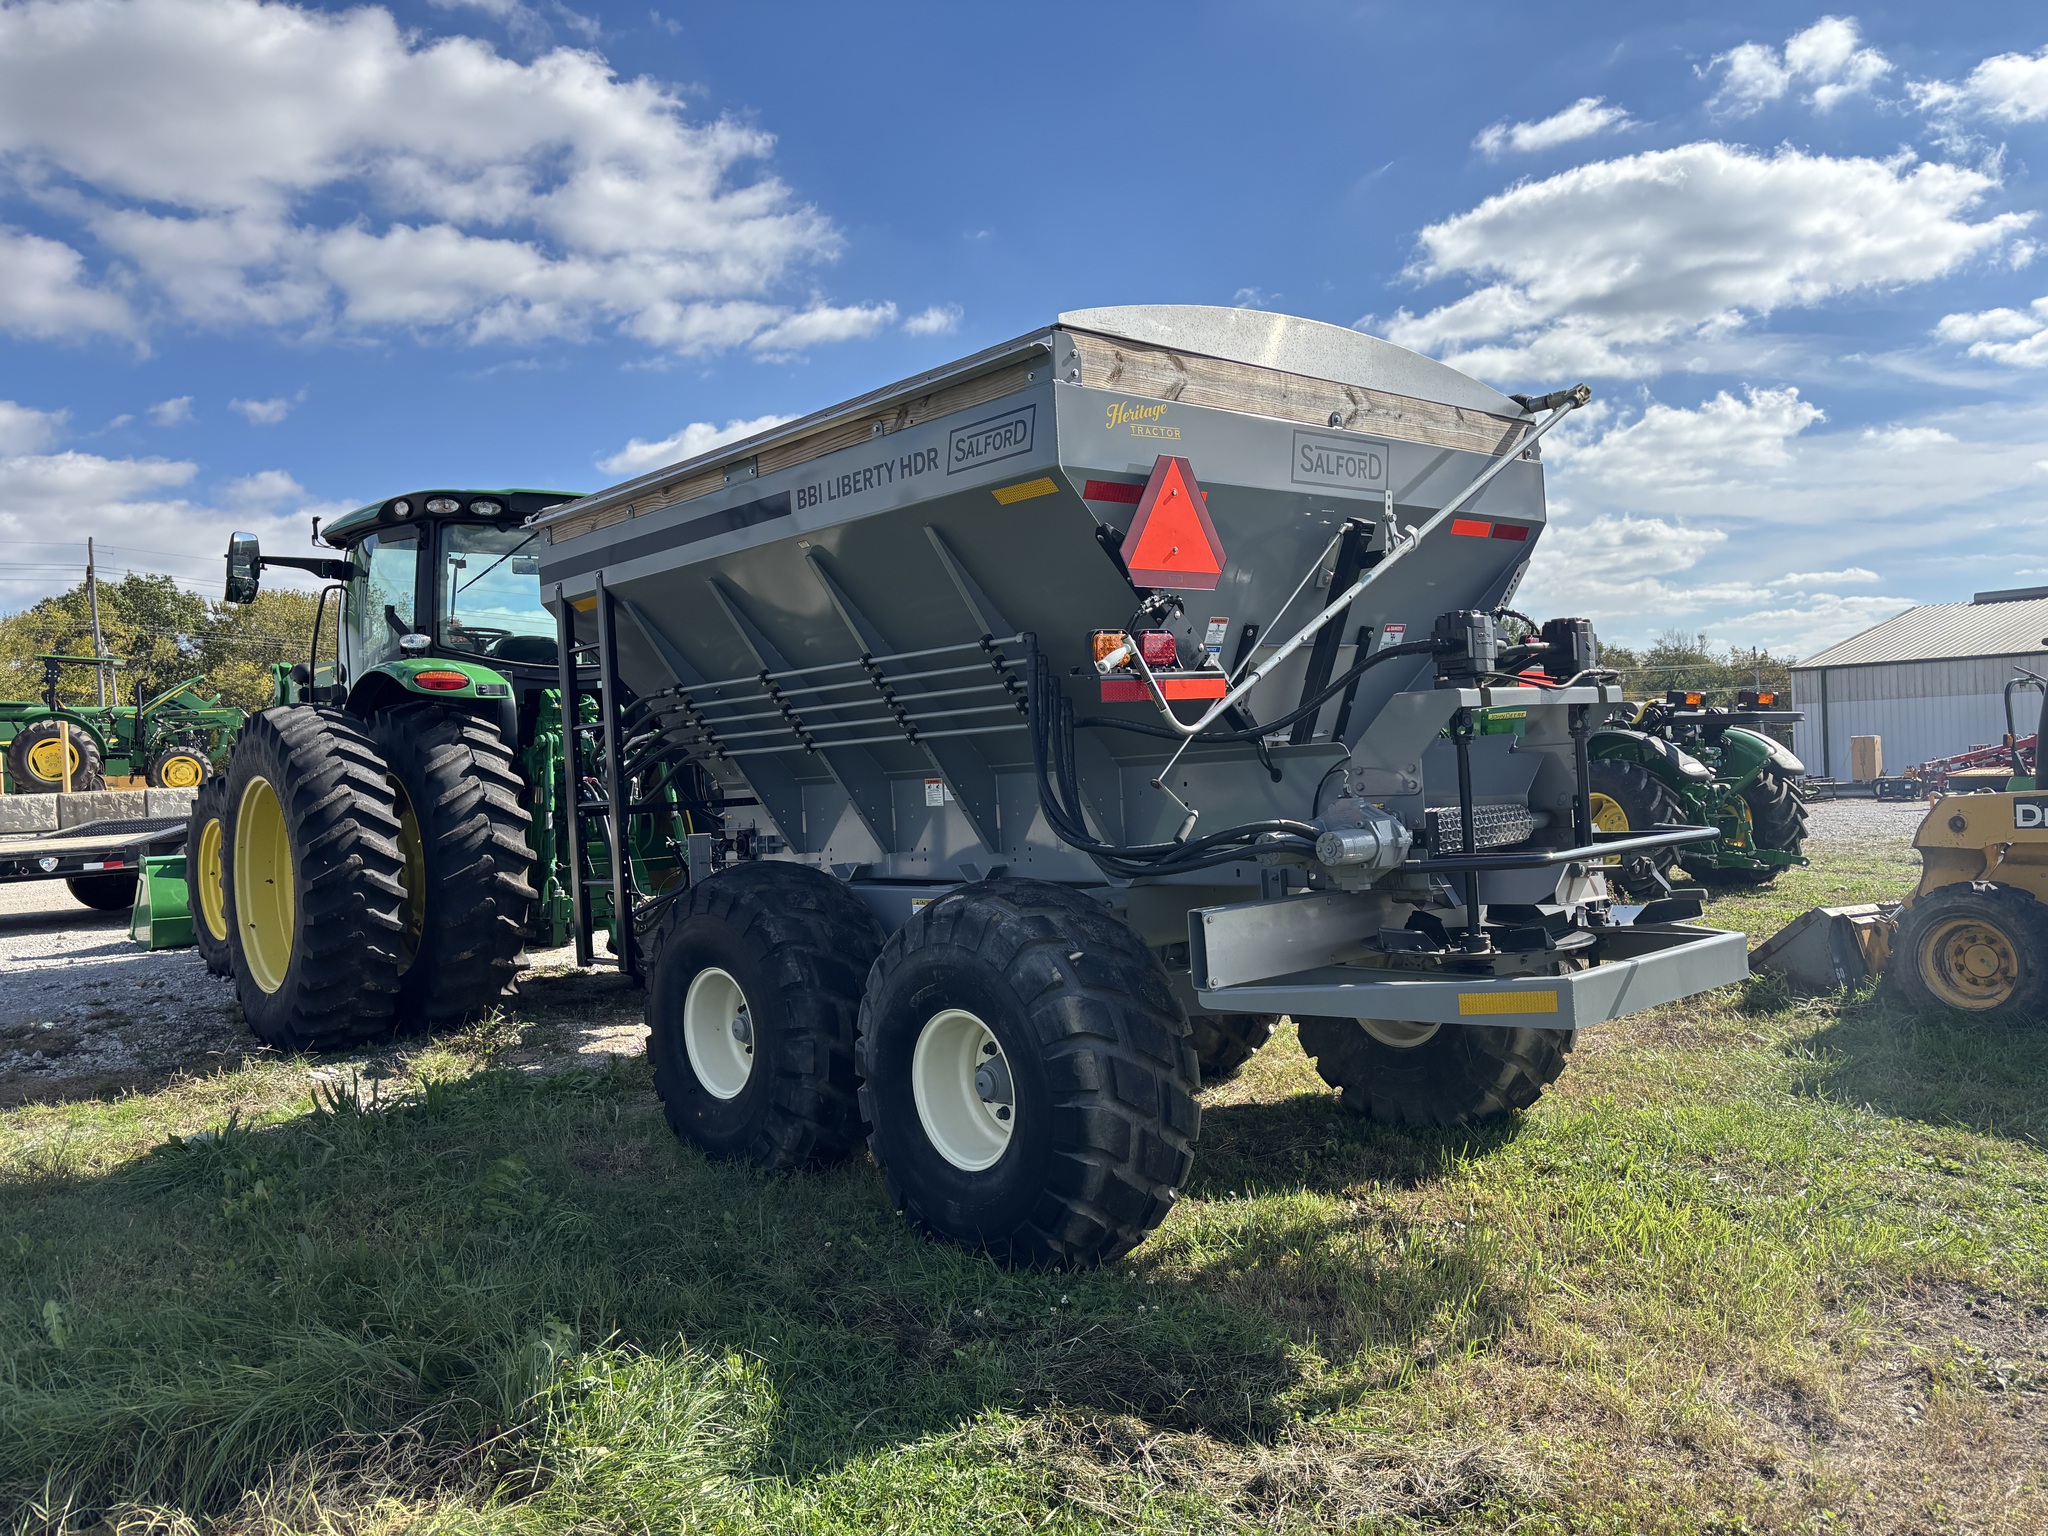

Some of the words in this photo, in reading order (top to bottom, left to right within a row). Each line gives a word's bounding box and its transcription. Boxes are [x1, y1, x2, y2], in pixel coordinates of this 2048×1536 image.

[1105, 401, 1168, 429] Heritage
[1130, 425, 1181, 438] TRACTOR
[955, 419, 1027, 462] SALFORD
[797, 483, 822, 510] BBI
[827, 460, 895, 501] LIBERTY
[900, 447, 939, 479] HDR
[1300, 444, 1382, 480] SALFORD
